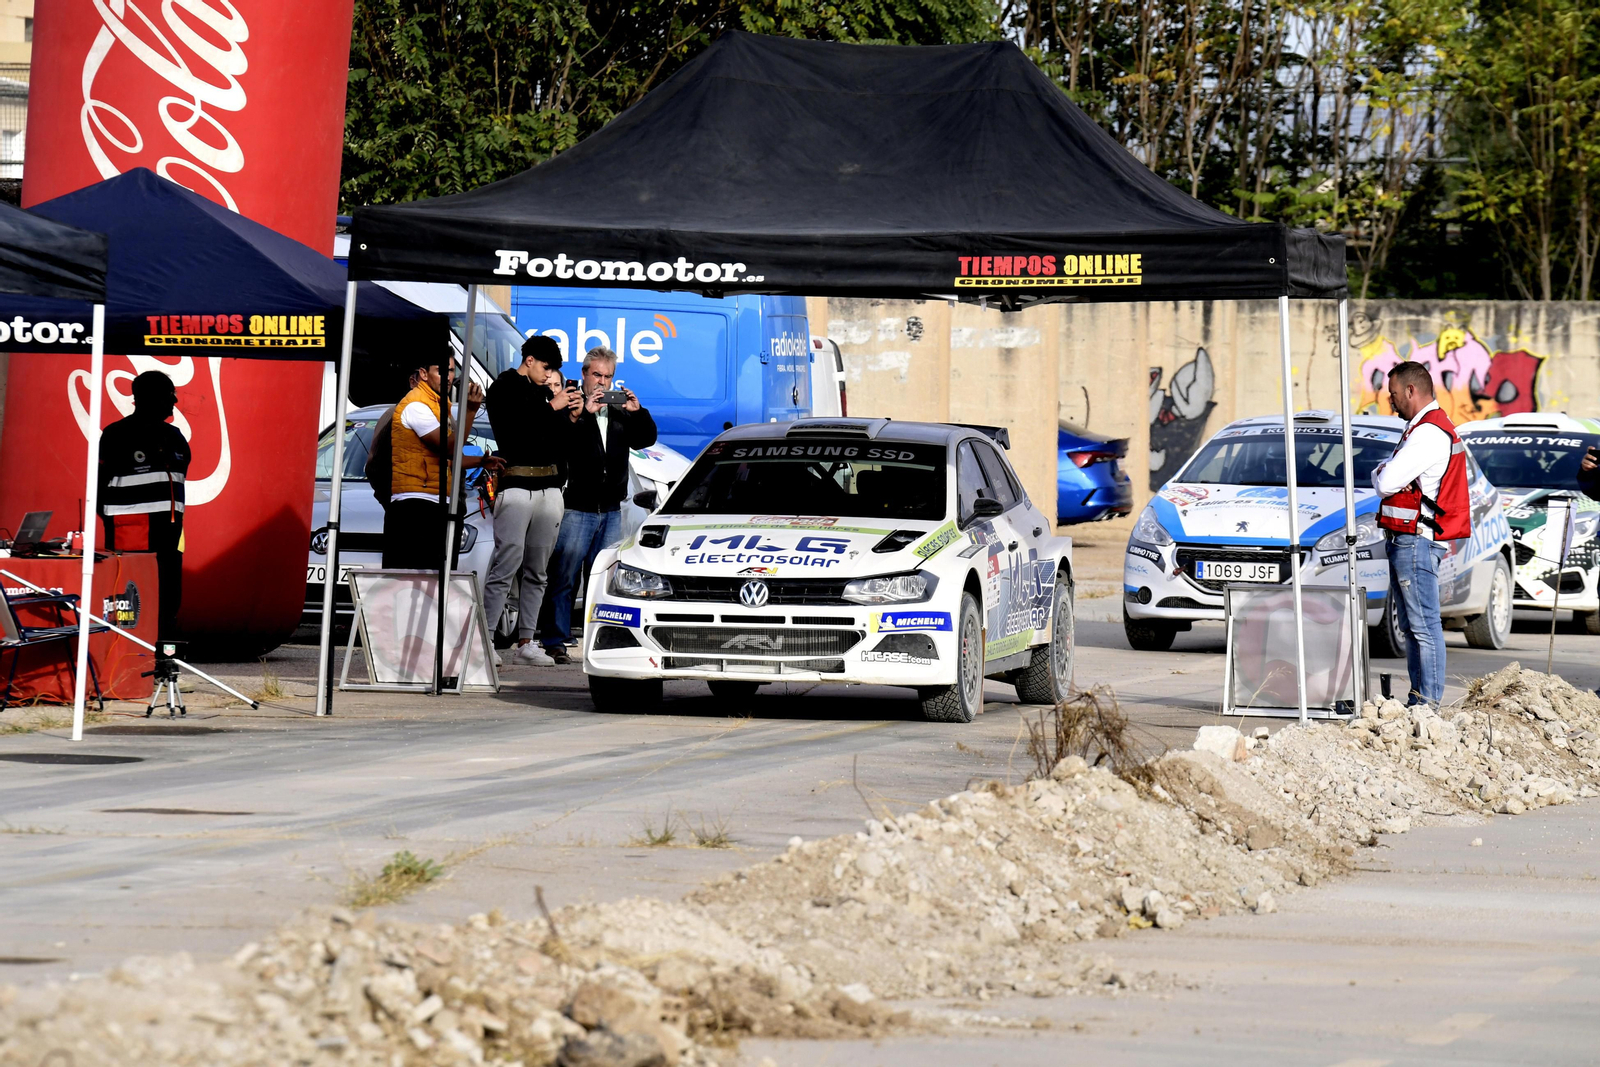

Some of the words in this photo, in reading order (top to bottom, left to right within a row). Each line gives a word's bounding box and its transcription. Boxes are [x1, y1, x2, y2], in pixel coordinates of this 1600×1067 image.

[493, 250, 765, 283] Fotomotor.es
[958, 255, 1056, 276] TIEMPOS
[1063, 254, 1142, 275] ONLINE
[958, 277, 1139, 286] CRONOMETRAJE
[146, 314, 243, 335] TIEMPOS
[249, 315, 325, 335] ONLINE
[148, 337, 322, 346] CRONOMETRAJE
[1464, 436, 1533, 446] KUMHO
[1536, 437, 1583, 447] TYRE
[733, 445, 859, 458] SAMSUNG
[867, 449, 915, 461] SSD
[1206, 564, 1242, 578] 1069
[1249, 565, 1276, 579] JSF
[598, 610, 633, 621] MICHELIN
[895, 617, 945, 627] MICHELIN
